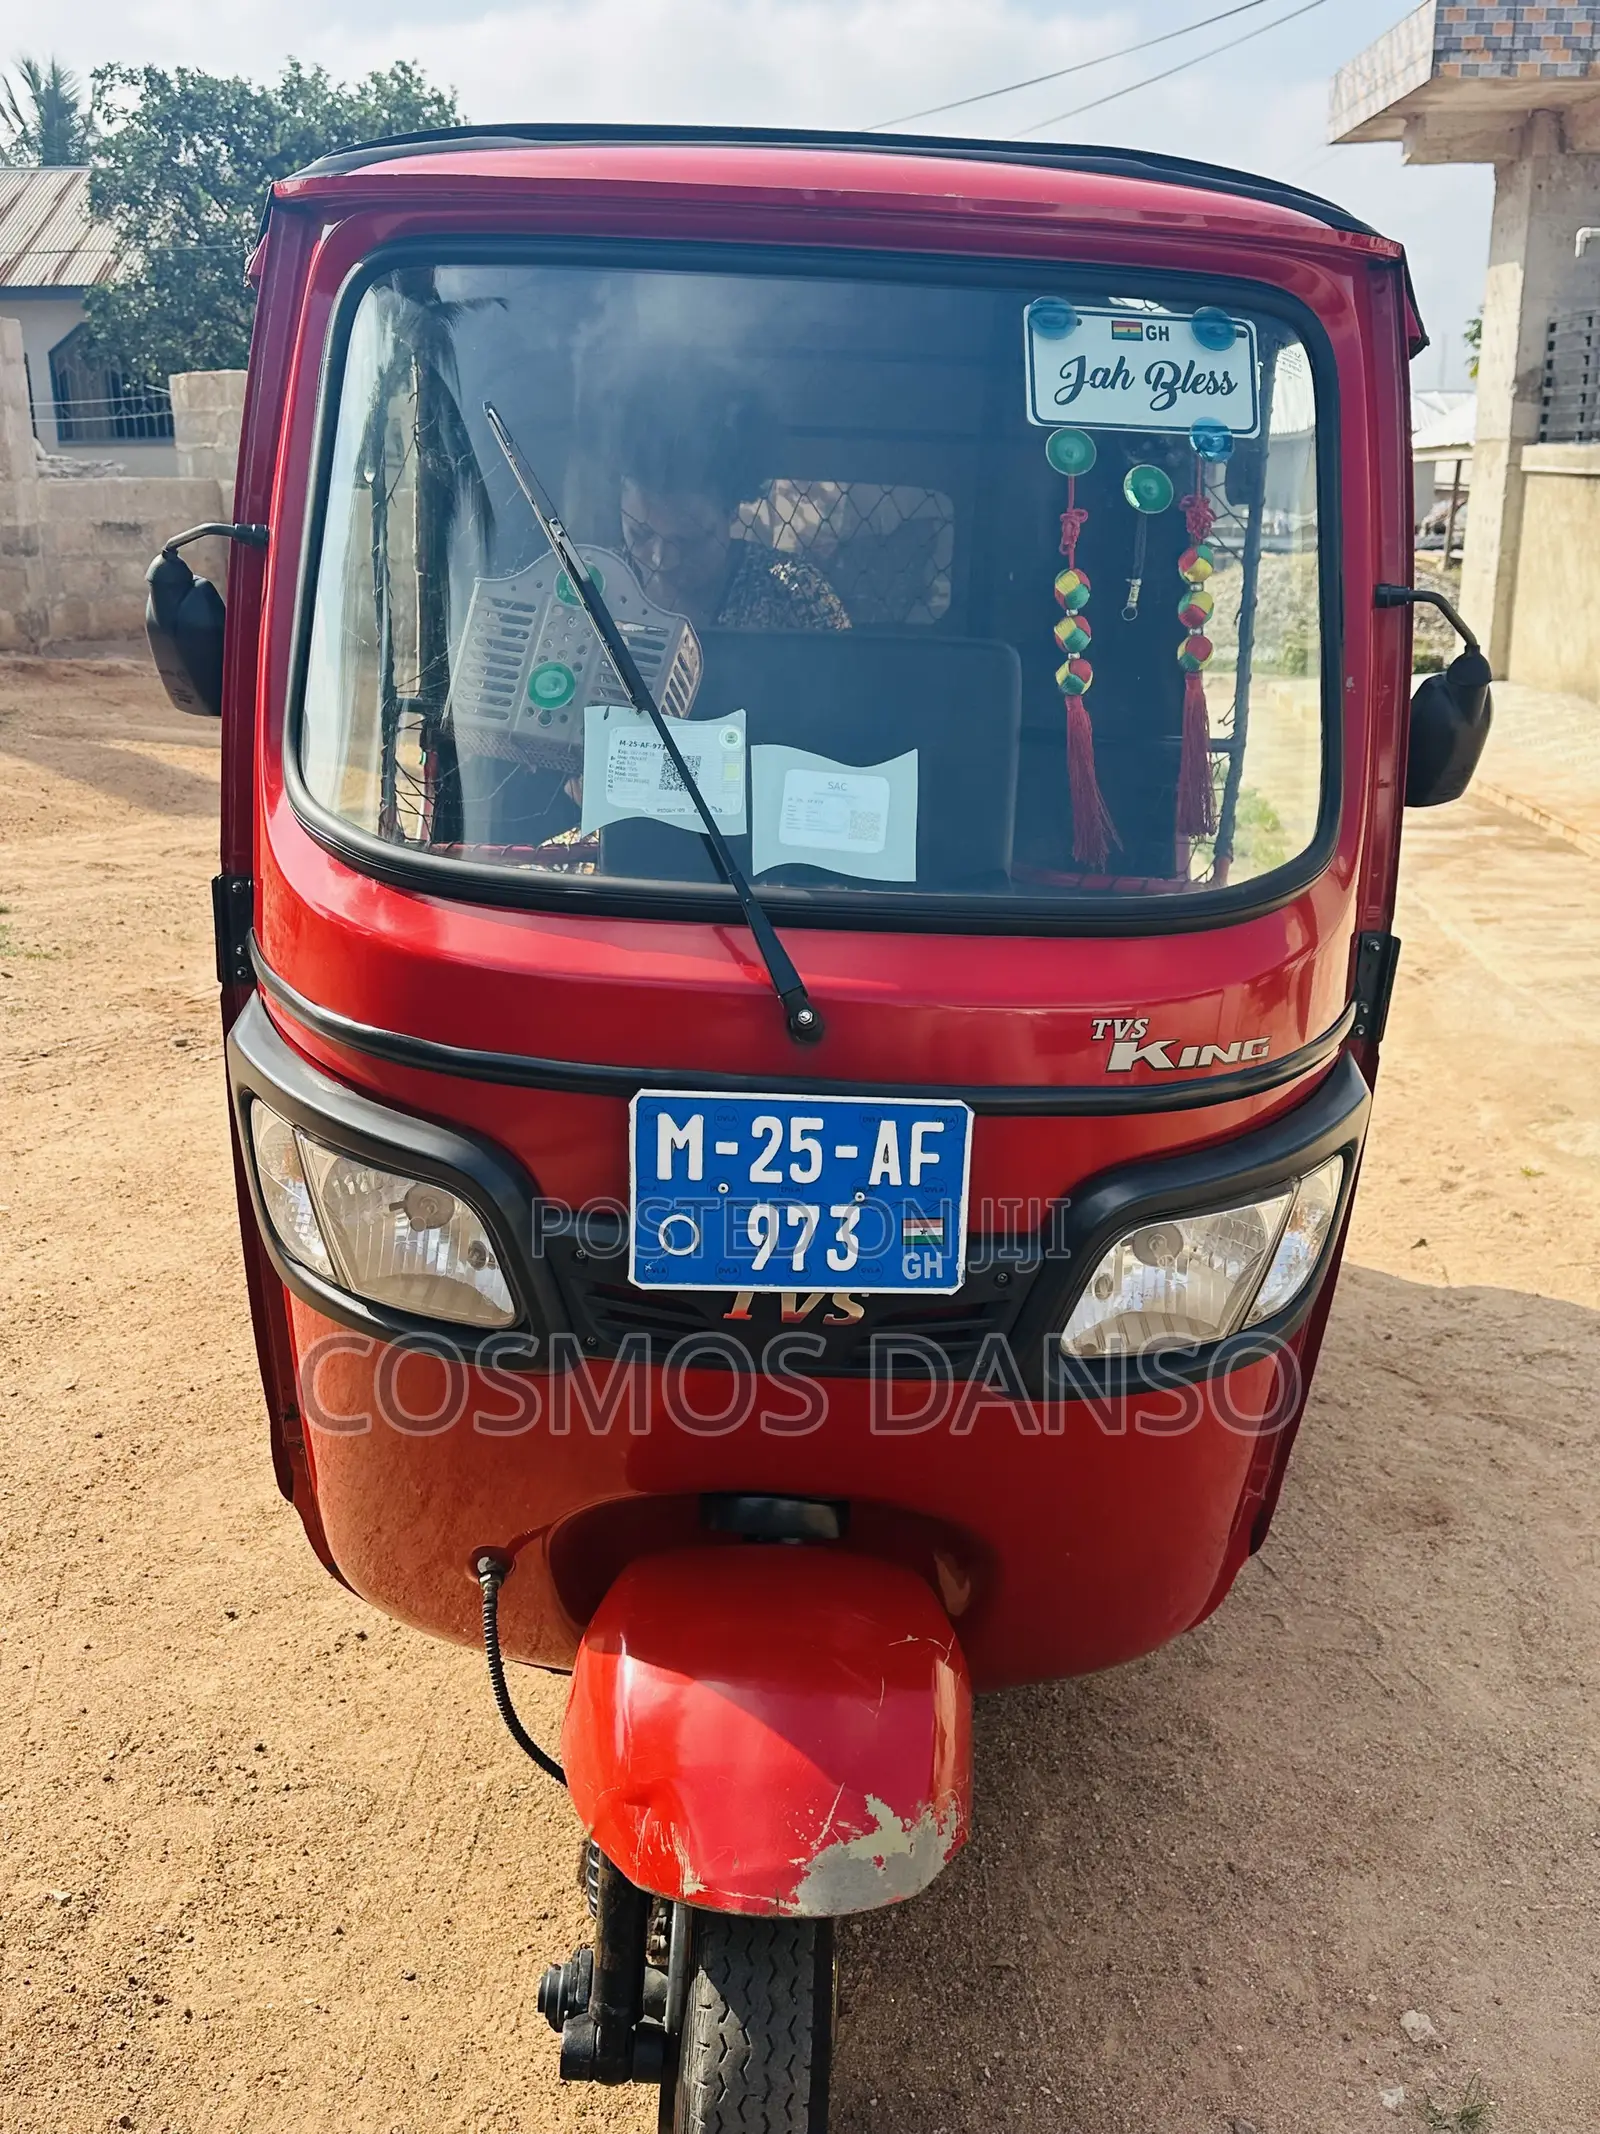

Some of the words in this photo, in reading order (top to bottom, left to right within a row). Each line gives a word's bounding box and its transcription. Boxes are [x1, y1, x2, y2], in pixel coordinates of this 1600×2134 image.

[1146, 325, 1170, 342] GH
[1054, 355, 1135, 406] Jah
[1145, 360, 1238, 411] Bless
[827, 781, 848, 791] SAC
[1091, 1018, 1149, 1040] TVS
[1105, 1036, 1272, 1072] KING
[747, 1203, 862, 1272] 973
[901, 1252, 944, 1280] GH
